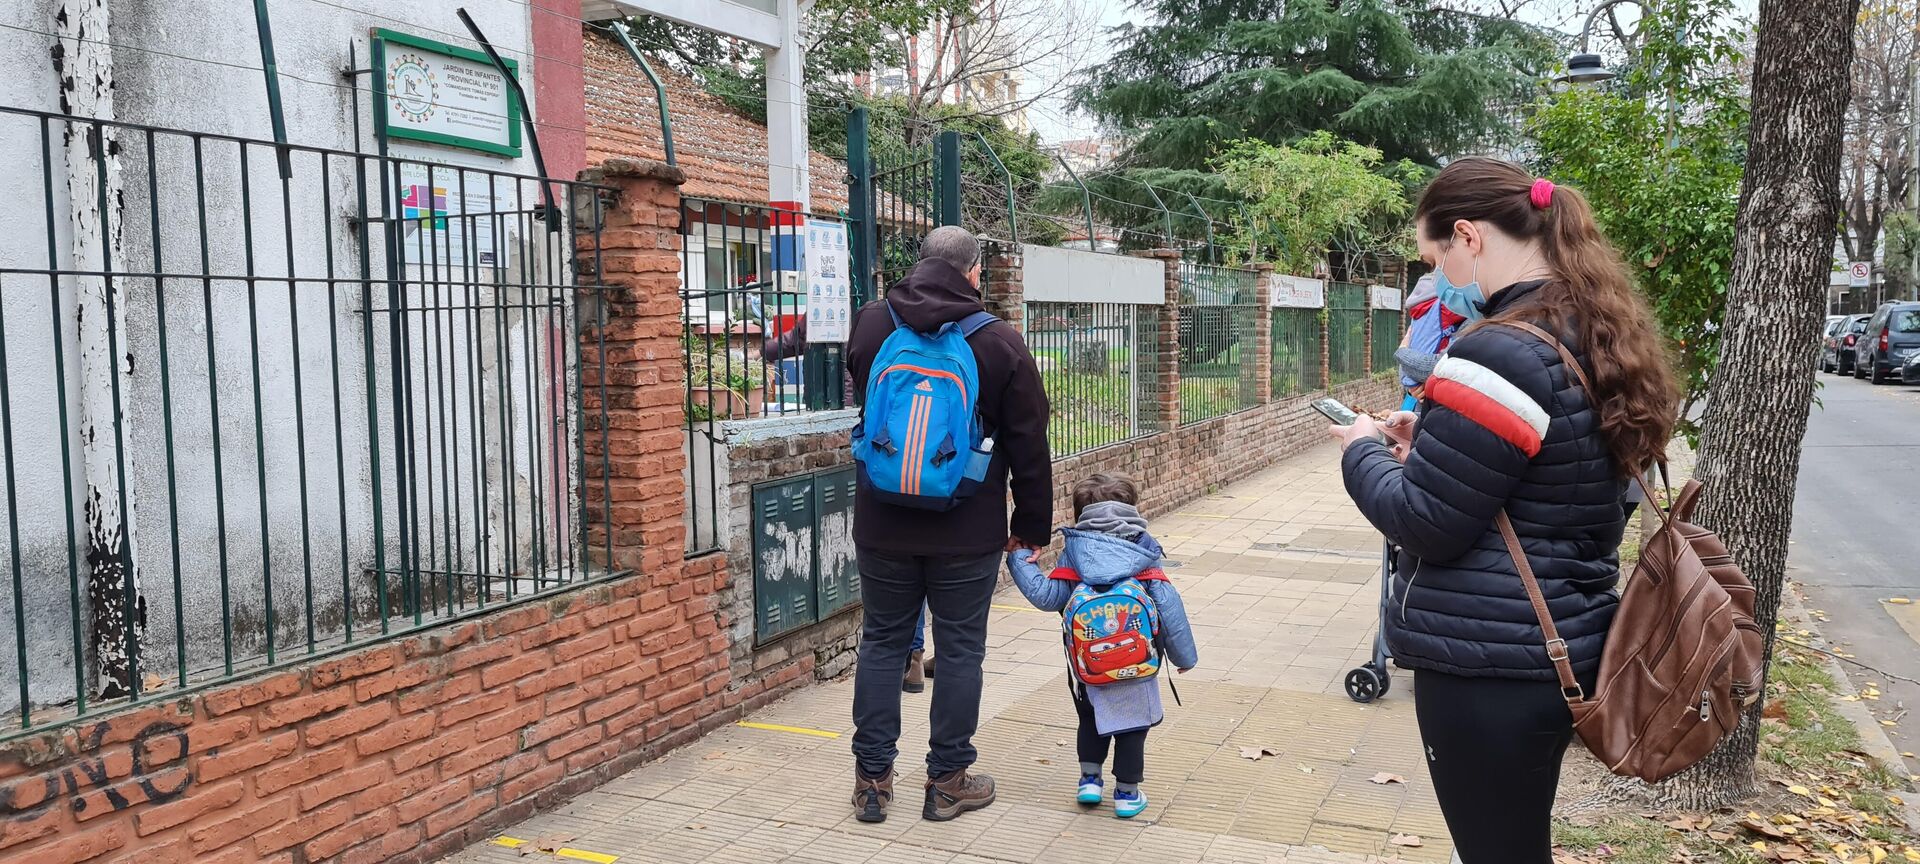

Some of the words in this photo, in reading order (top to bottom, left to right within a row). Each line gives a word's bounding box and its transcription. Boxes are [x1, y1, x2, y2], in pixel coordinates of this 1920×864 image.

[443, 63, 464, 74] JARDIN
[465, 68, 473, 76] DE
[474, 70, 501, 82] INFANTES
[447, 74, 482, 87] PROVINCIAL
[1117, 667, 1139, 678] 95
